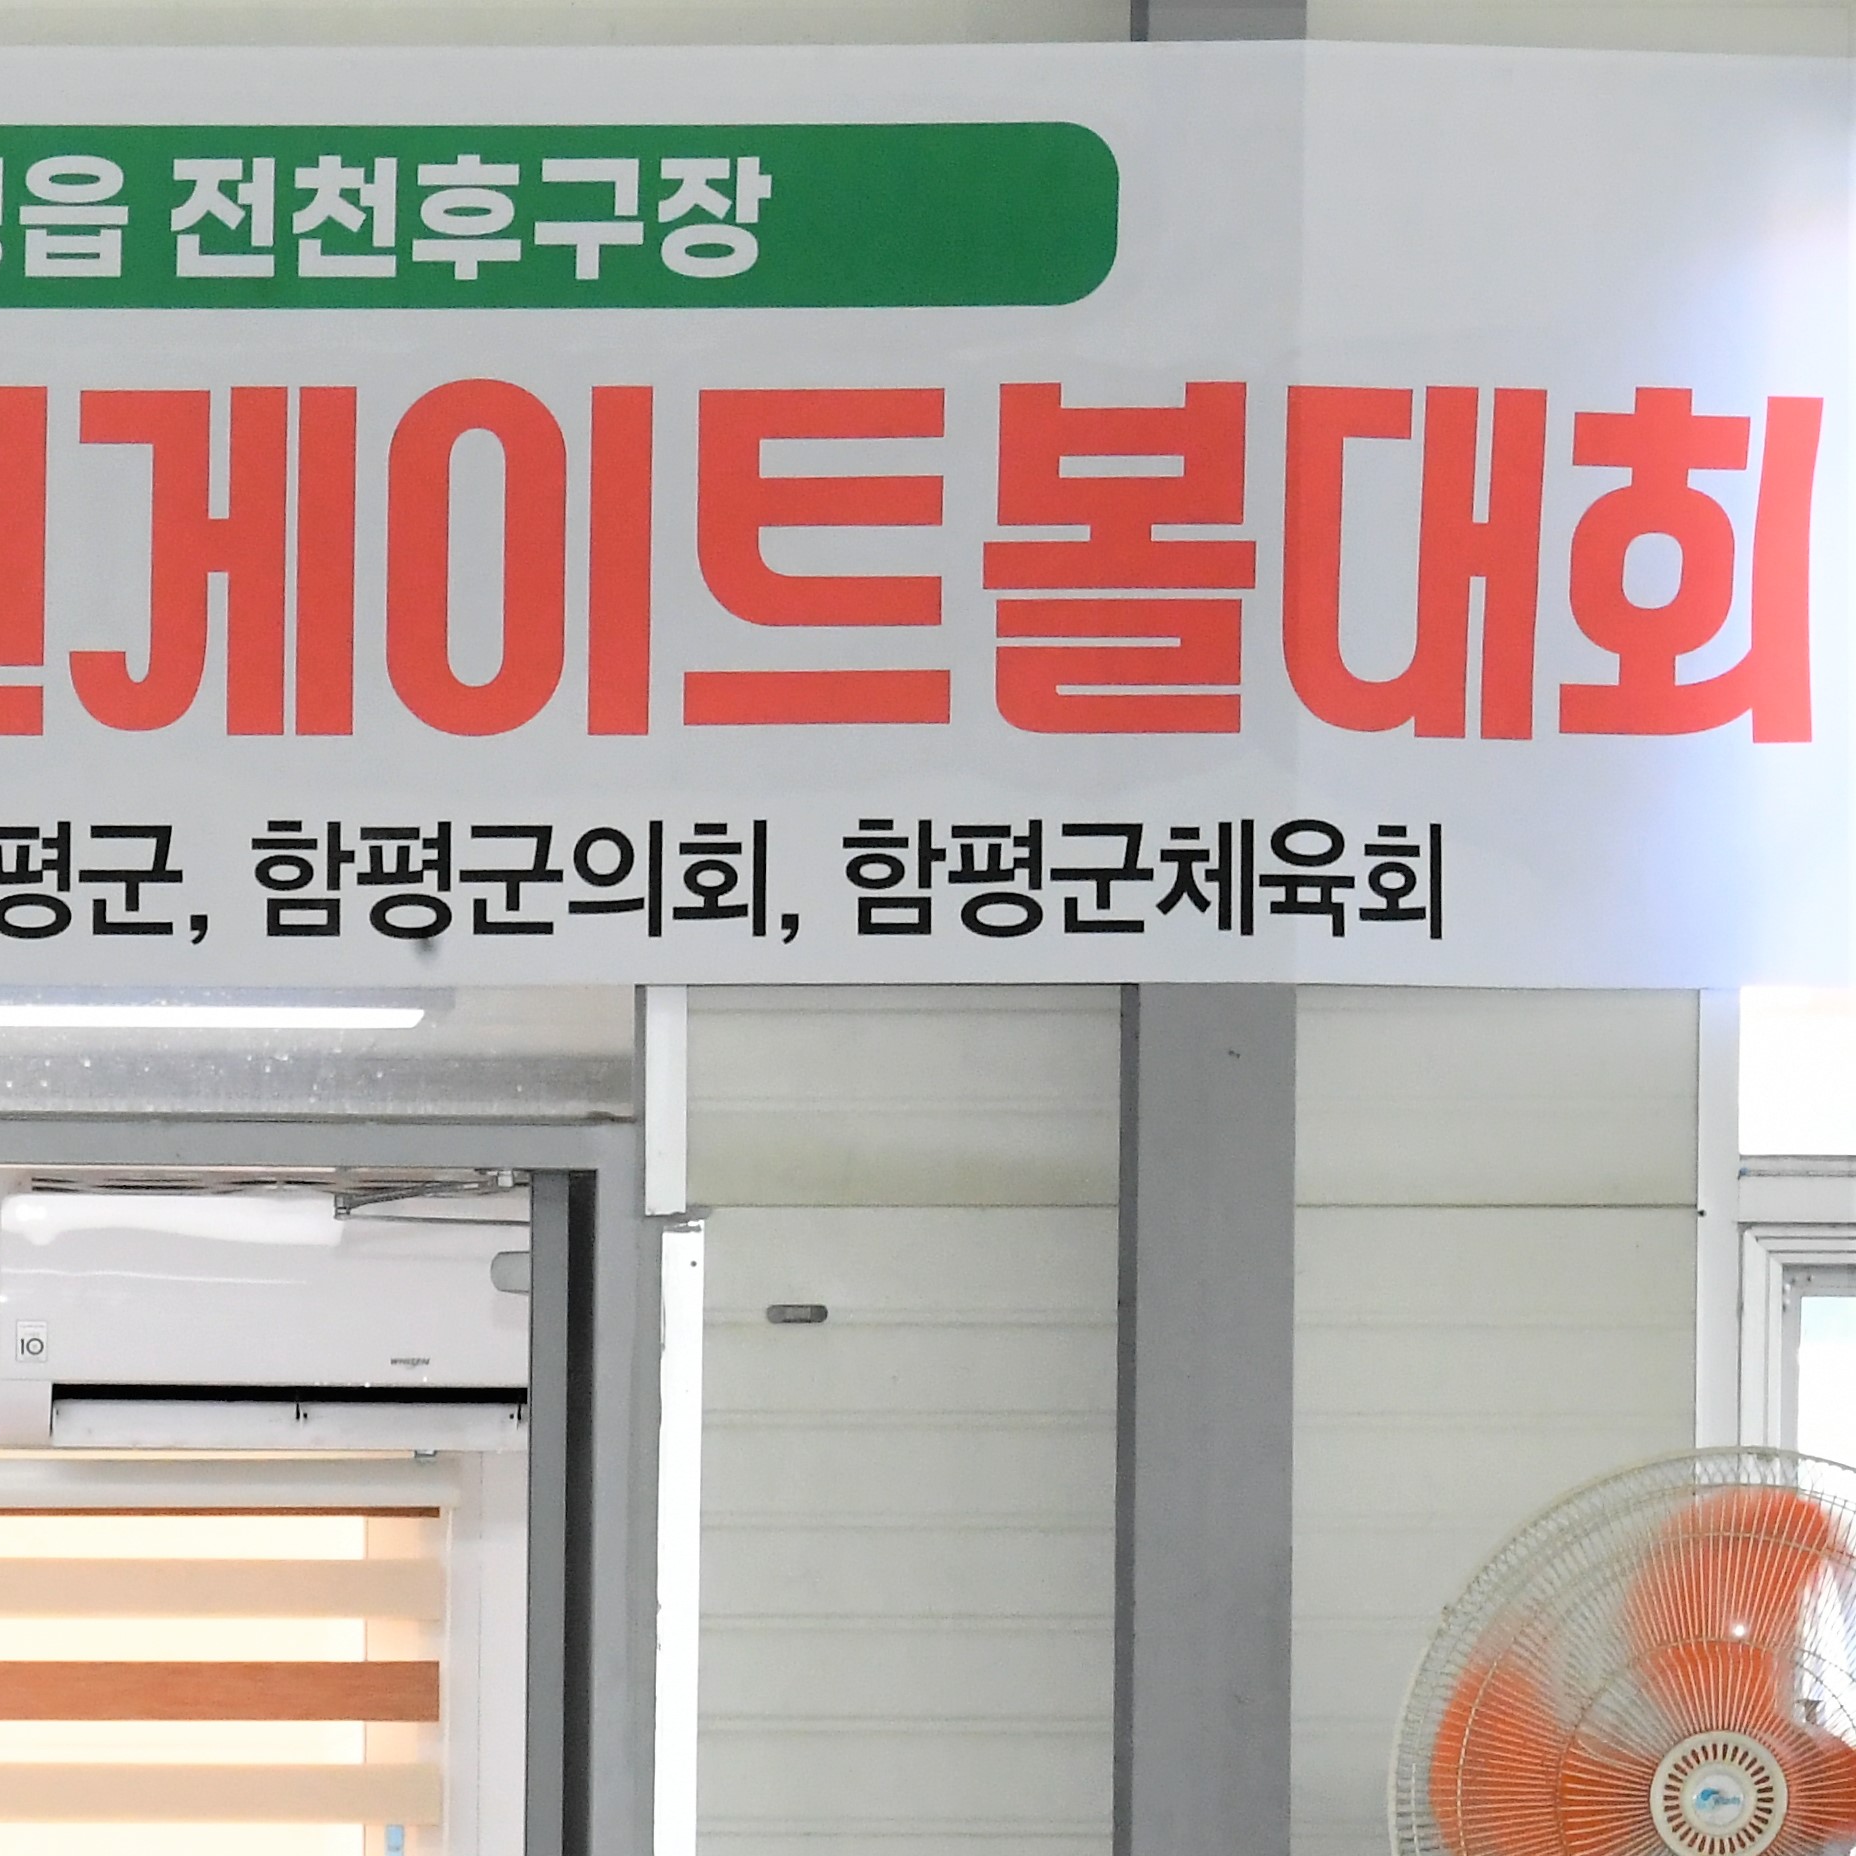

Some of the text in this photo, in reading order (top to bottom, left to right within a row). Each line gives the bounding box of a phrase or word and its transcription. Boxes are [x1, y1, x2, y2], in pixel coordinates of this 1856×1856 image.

[169, 153, 772, 281] 전천후구장
[250, 818, 800, 945] 함평군의회,
[841, 817, 1448, 941] 함평군체육회
